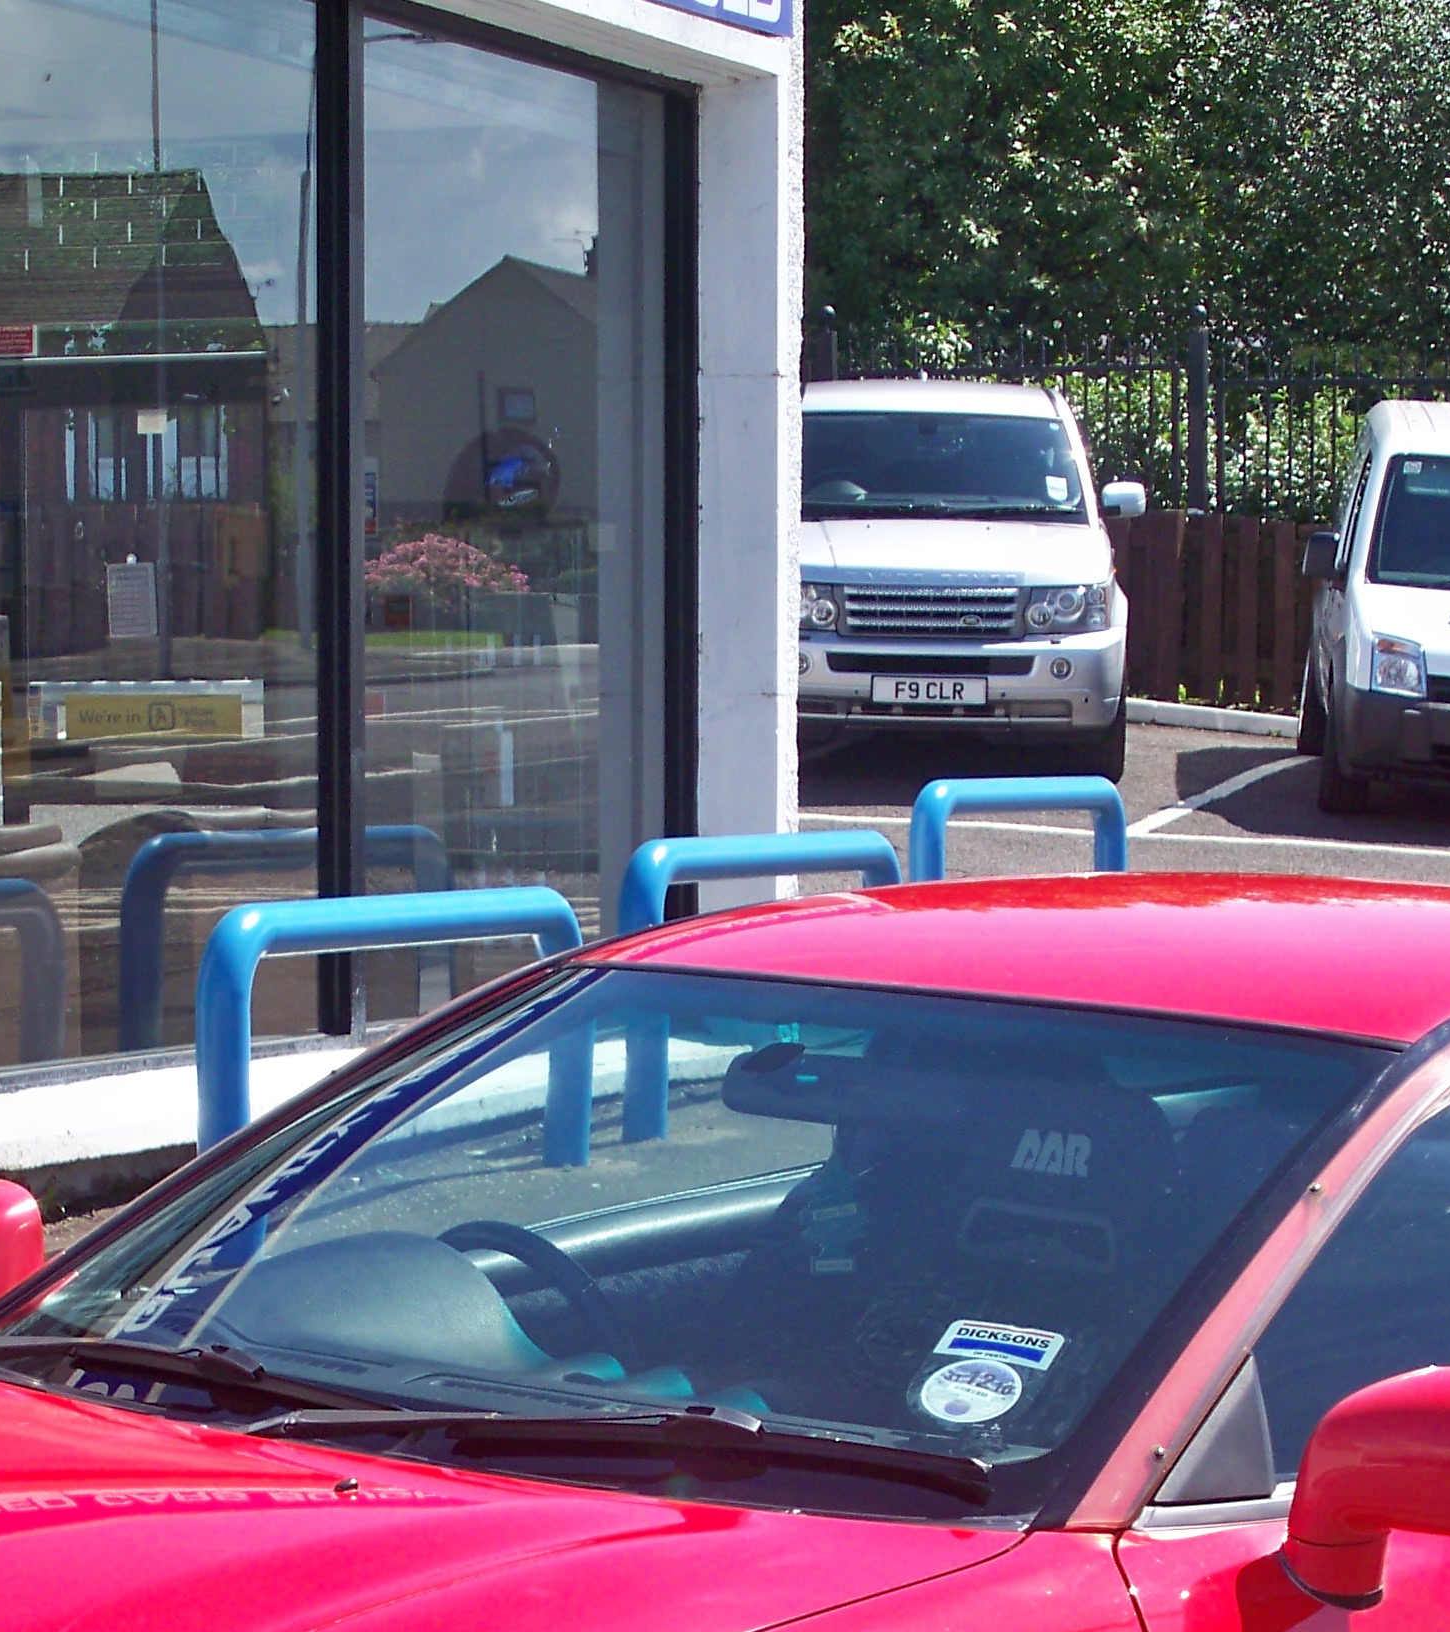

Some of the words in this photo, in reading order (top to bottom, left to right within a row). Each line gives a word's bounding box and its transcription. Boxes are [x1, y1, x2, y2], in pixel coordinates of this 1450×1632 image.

[894, 682, 920, 699] F9
[925, 682, 965, 700] CLR
[126, 710, 141, 723] in
[957, 1327, 1052, 1349] DICKSONS
